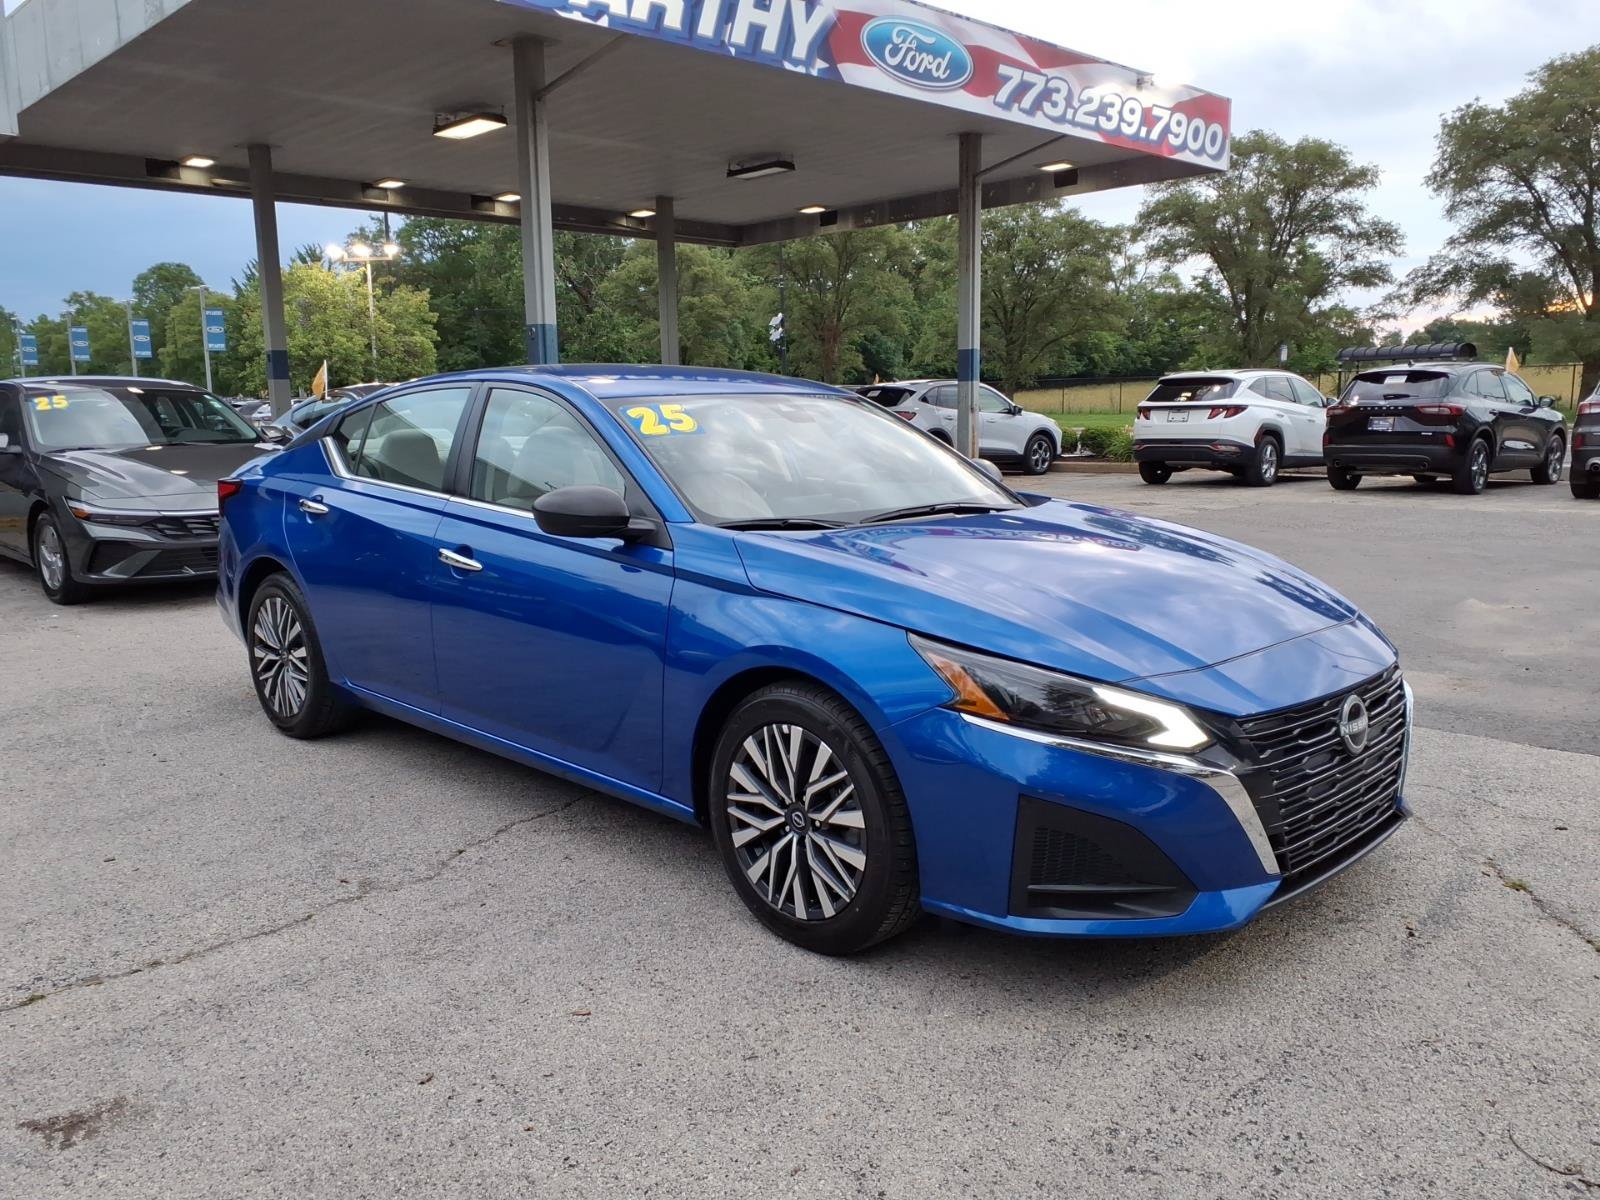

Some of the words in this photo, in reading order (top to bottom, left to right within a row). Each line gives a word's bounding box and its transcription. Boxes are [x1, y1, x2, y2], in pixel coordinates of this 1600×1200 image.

[885, 26, 952, 80] Ford
[994, 64, 1224, 157] 773.239.7900
[34, 394, 69, 410] 25
[626, 404, 698, 435] 25
